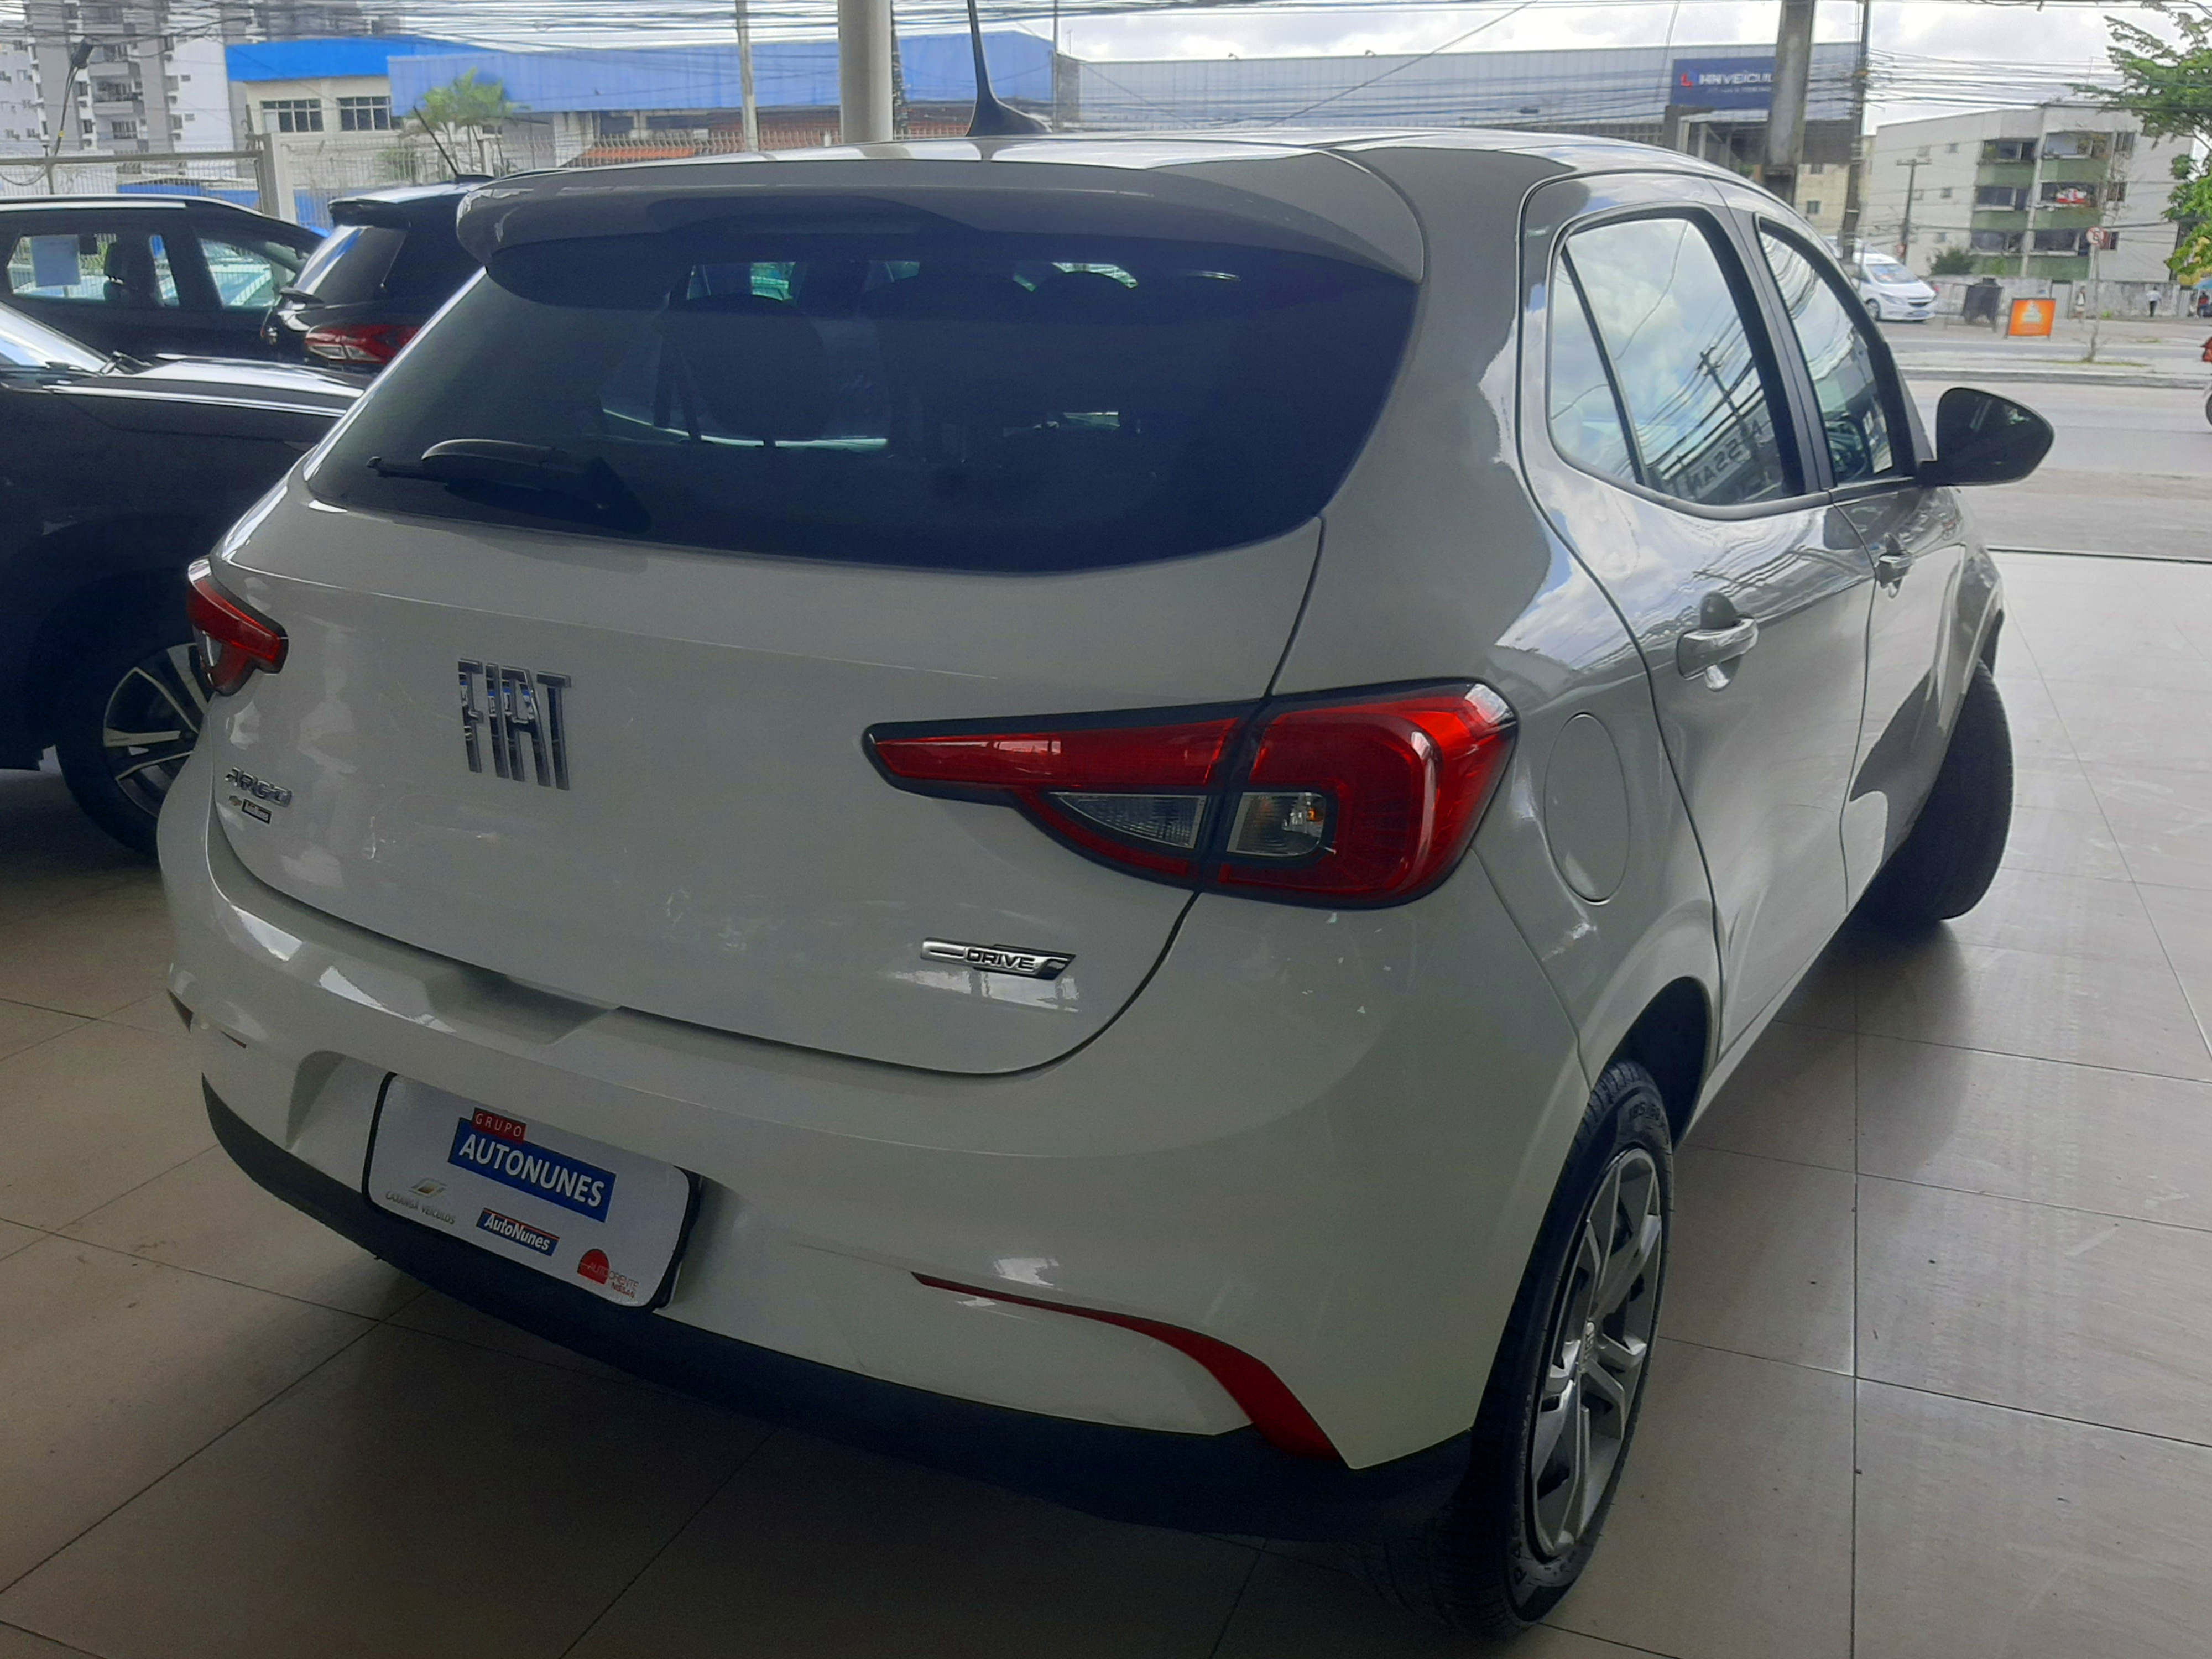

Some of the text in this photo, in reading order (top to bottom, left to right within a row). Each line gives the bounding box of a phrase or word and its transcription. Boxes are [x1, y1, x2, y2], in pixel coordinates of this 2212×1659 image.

[458, 658, 571, 791] FIAT
[225, 766, 293, 807] ARGO
[966, 948, 1036, 971] DRIVE
[475, 1113, 522, 1138] GRUPO
[458, 1134, 604, 1207] AUTONUNES
[484, 1213, 550, 1250] AutoNunes
